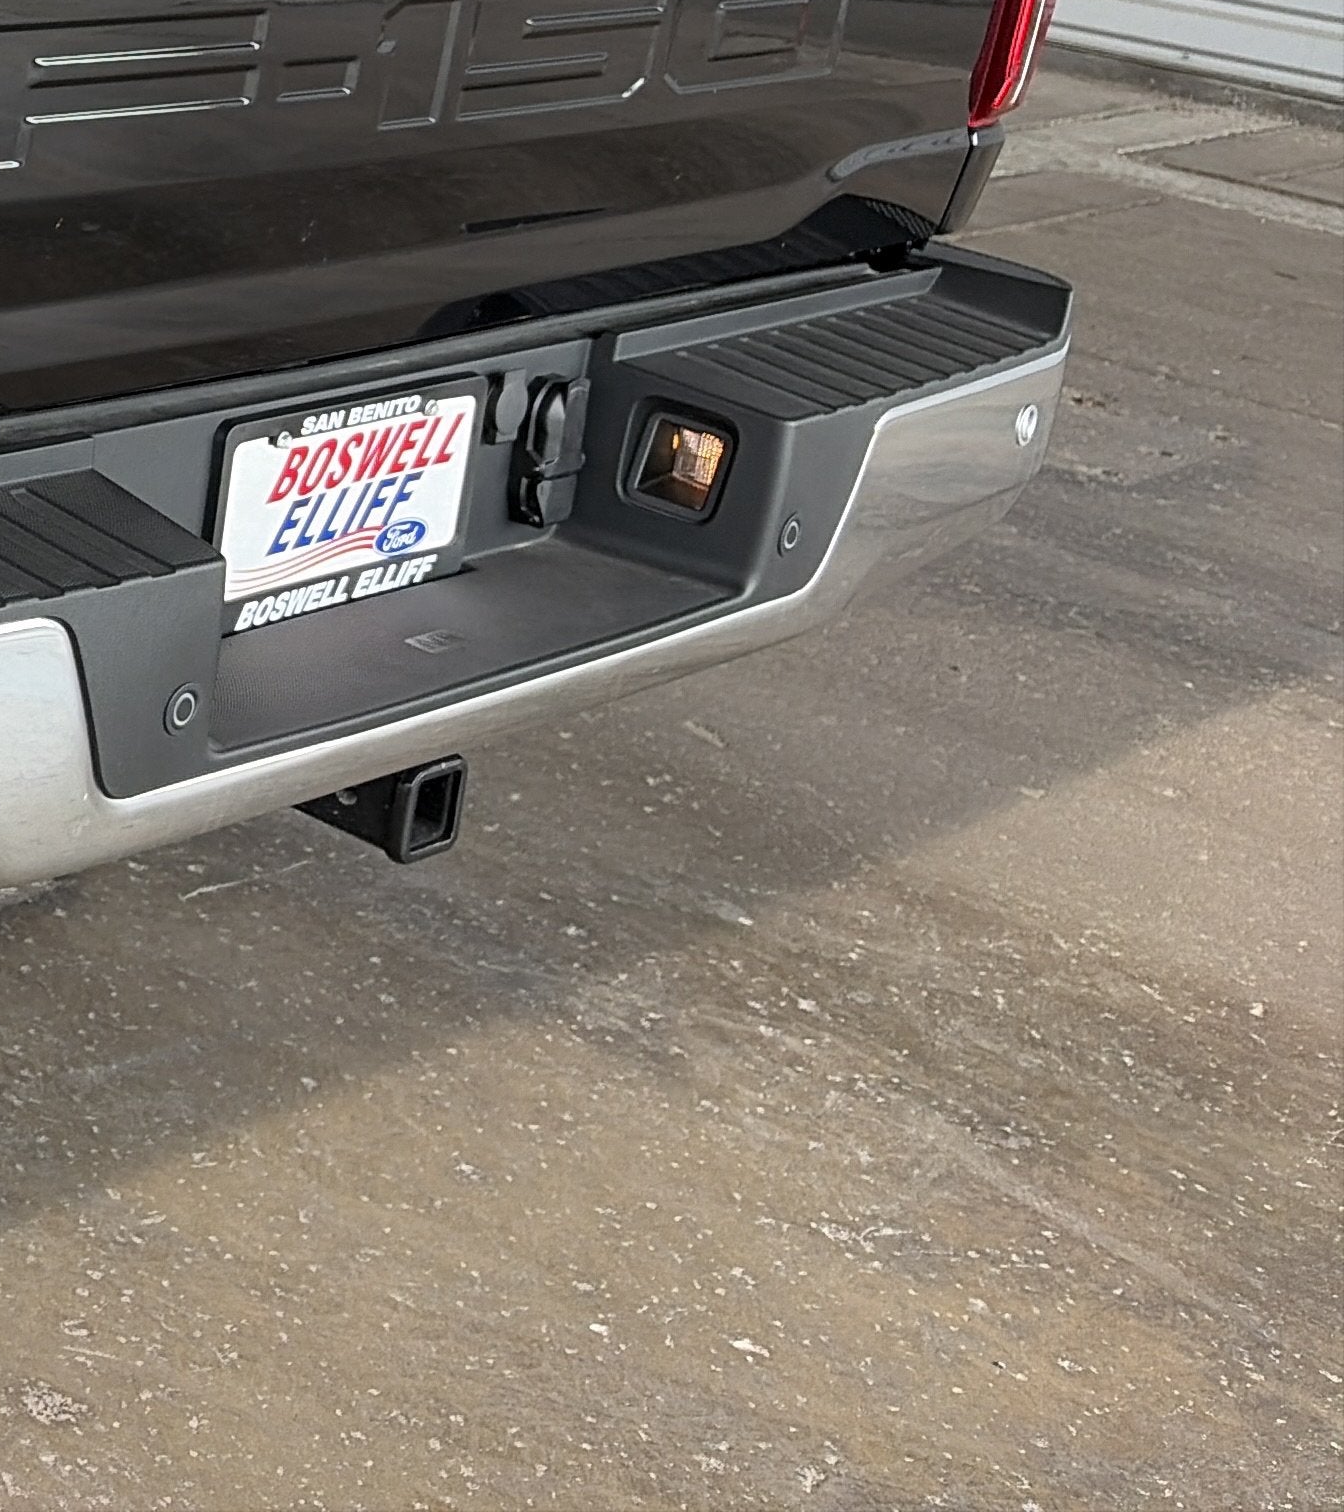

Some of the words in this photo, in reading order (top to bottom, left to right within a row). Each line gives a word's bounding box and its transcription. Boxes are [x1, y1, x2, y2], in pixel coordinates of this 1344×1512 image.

[300, 409, 346, 437] SAN
[347, 394, 422, 427] BENITO
[265, 412, 467, 504] BOSWELL
[265, 470, 425, 558] ELLIFF
[381, 526, 422, 554] Ford
[234, 574, 349, 632] BOSWELL
[350, 553, 438, 601] ELLIFF
